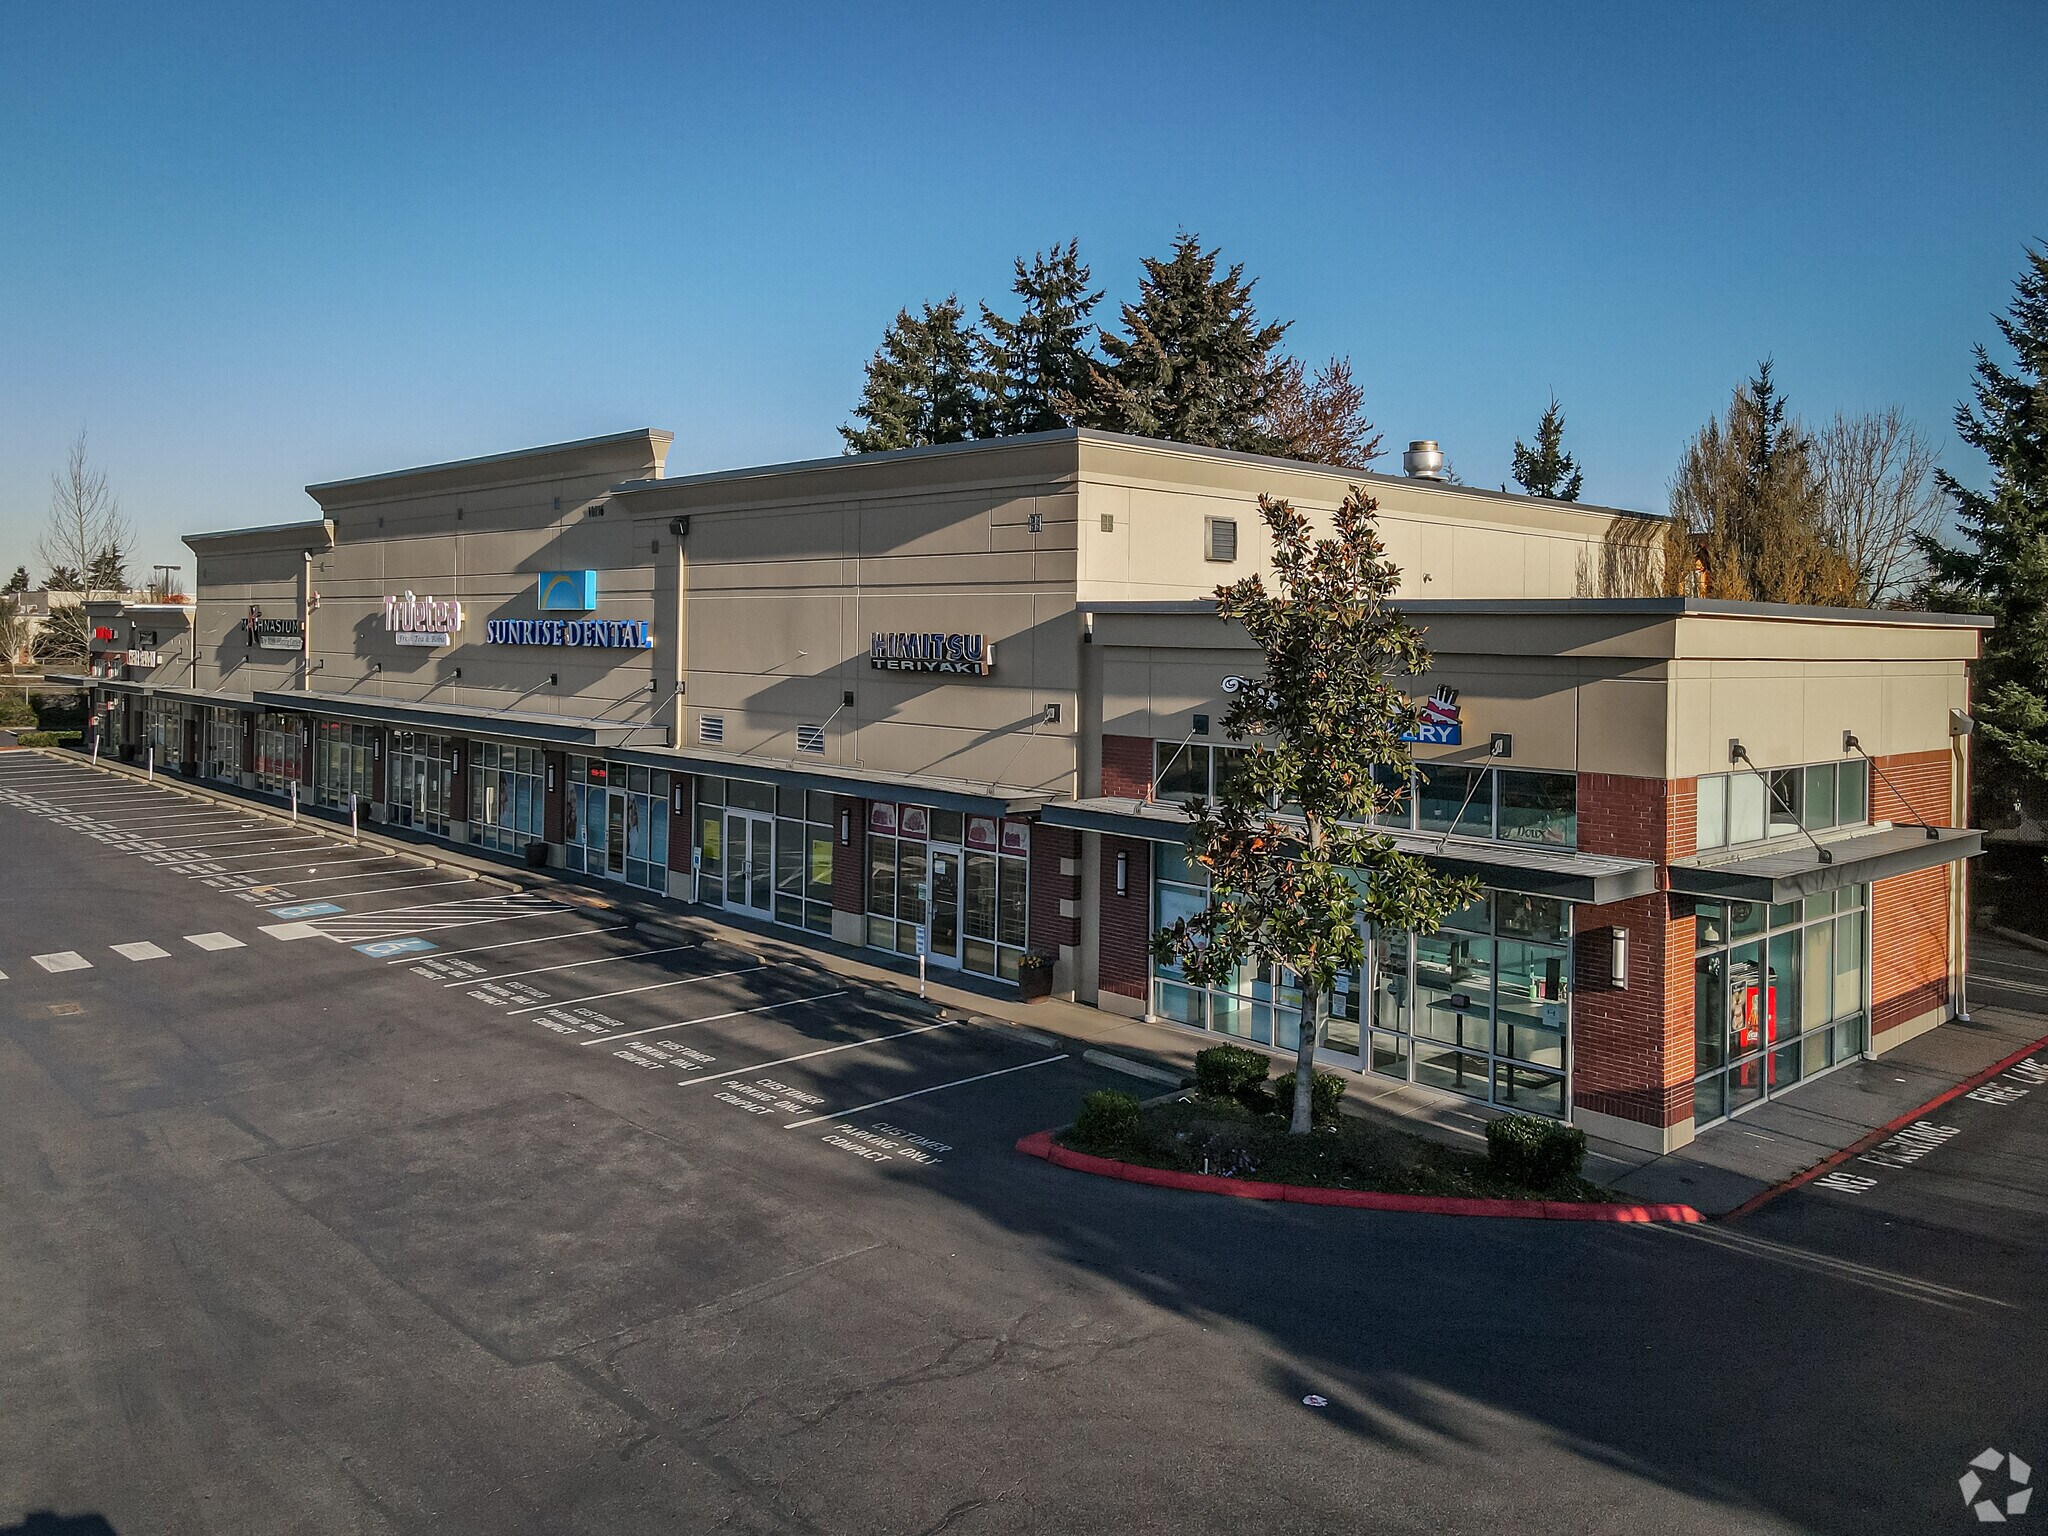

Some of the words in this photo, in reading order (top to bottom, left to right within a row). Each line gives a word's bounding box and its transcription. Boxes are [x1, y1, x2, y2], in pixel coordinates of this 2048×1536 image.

[242, 619, 299, 634] MHNASIUM
[383, 595, 461, 632] Truetea
[486, 619, 564, 646] SUNRISE
[567, 619, 653, 649] DENTAL
[870, 632, 983, 662] HIMITSU
[872, 659, 981, 674] TERIYAKI
[612, 1050, 665, 1070] COMPACT
[624, 1041, 674, 1060] PARKING
[669, 1058, 703, 1071] ONLY
[657, 1040, 717, 1062] CUSTOMER
[713, 1092, 774, 1115] COMPACT
[721, 1080, 778, 1102] PARKING
[773, 1100, 813, 1115] ONLY
[756, 1078, 825, 1105] CUSTOMER
[821, 1134, 893, 1162] COMPACT
[834, 1123, 899, 1150] PARKING
[897, 1147, 943, 1165] ONLY
[871, 1122, 953, 1152] CUSTOMER
[1813, 1171, 1878, 1194] NO
[1857, 1120, 1961, 1169] PARKING
[1965, 1081, 2030, 1106] FIRE
